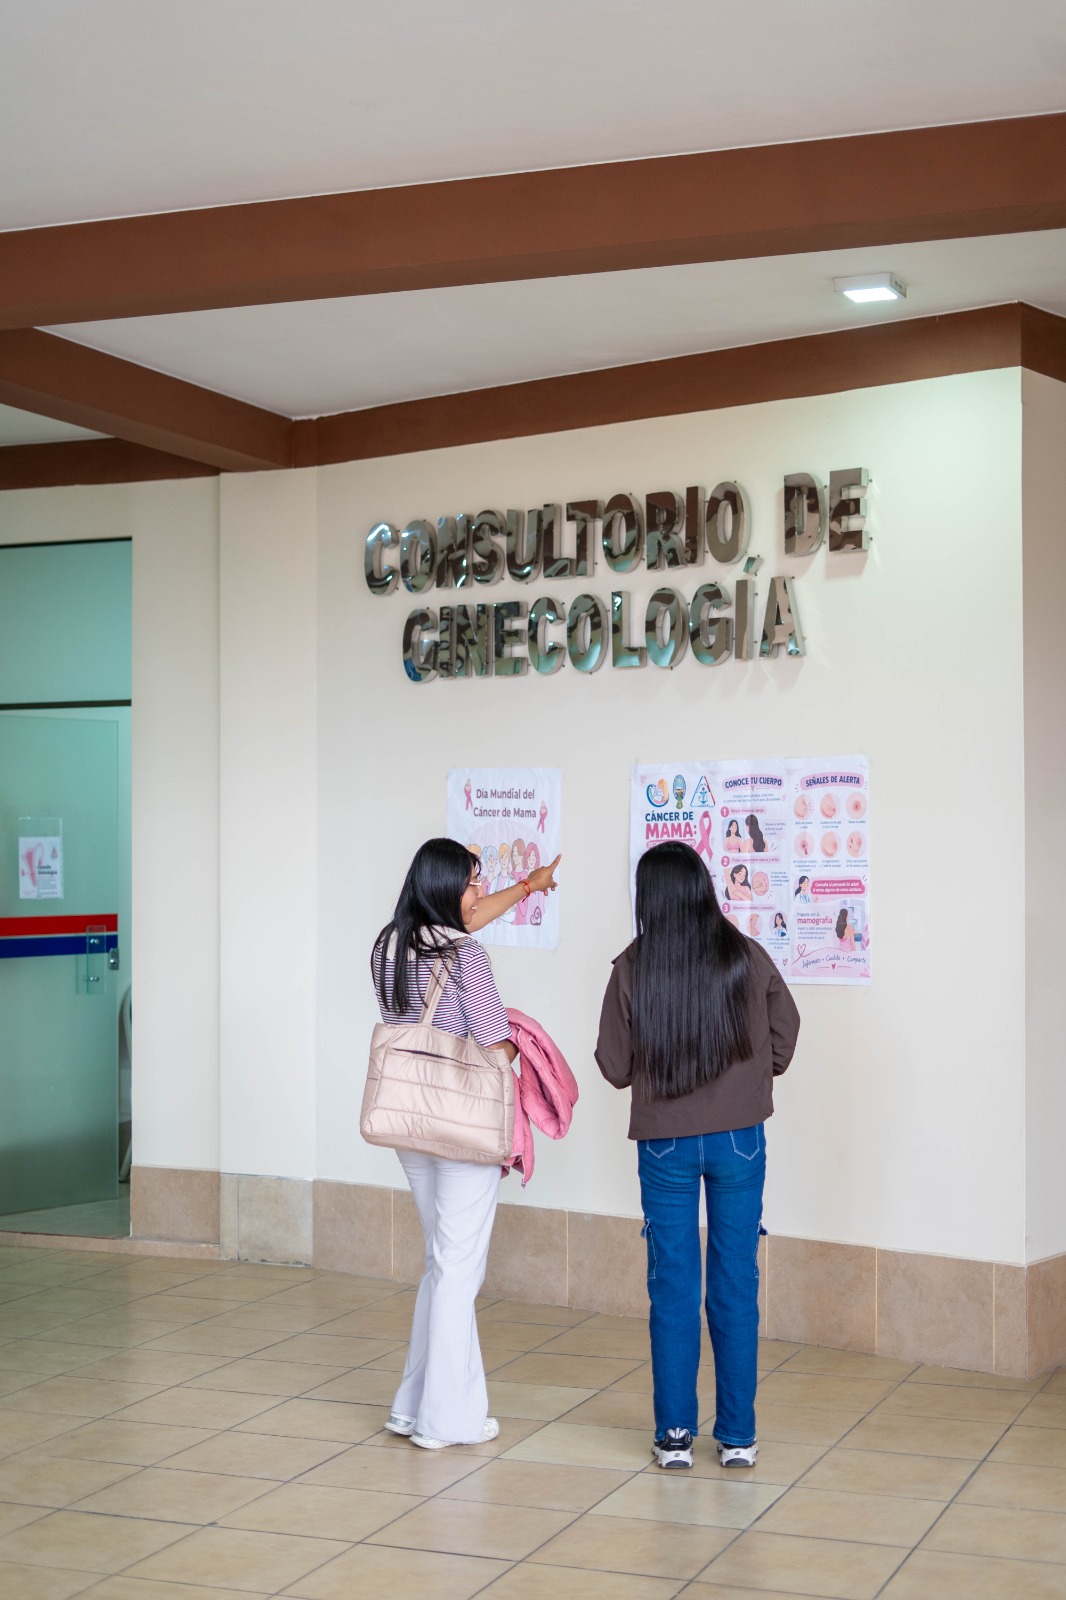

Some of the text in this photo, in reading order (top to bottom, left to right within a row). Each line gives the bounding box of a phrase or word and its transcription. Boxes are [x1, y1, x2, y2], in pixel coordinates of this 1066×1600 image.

[364, 467, 870, 596] CONSULTORIO DE
[403, 556, 806, 684] GINECOLOGÍA
[725, 777, 749, 788] CONOCE
[760, 777, 782, 786] CUERPO
[806, 776, 829, 787] SEÑALES
[839, 776, 860, 784] ALERTA
[476, 788, 534, 799] Día Mundial del
[473, 806, 536, 818] Cáncer de Mama
[645, 810, 694, 822] CÁNCER DE
[646, 822, 697, 840] MAMA:
